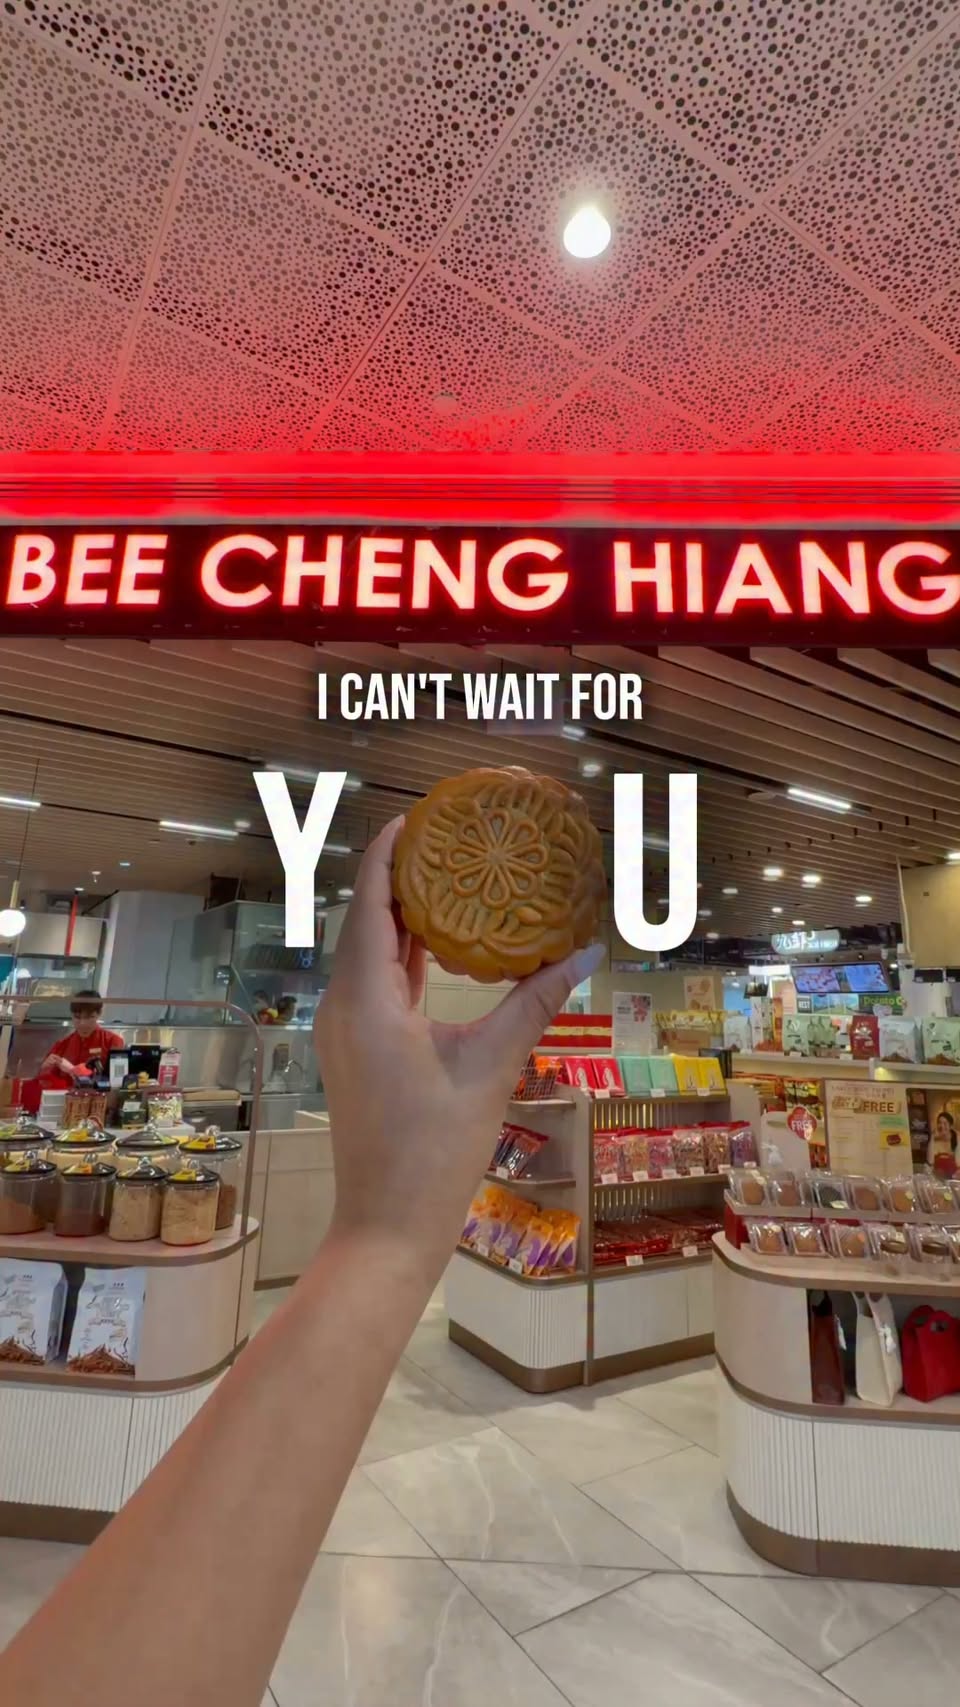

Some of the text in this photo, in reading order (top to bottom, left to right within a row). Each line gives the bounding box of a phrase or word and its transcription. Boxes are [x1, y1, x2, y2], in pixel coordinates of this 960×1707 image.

[7, 534, 960, 616] BEE CHENG HIANG
[862, 1100, 894, 1113] FREE
